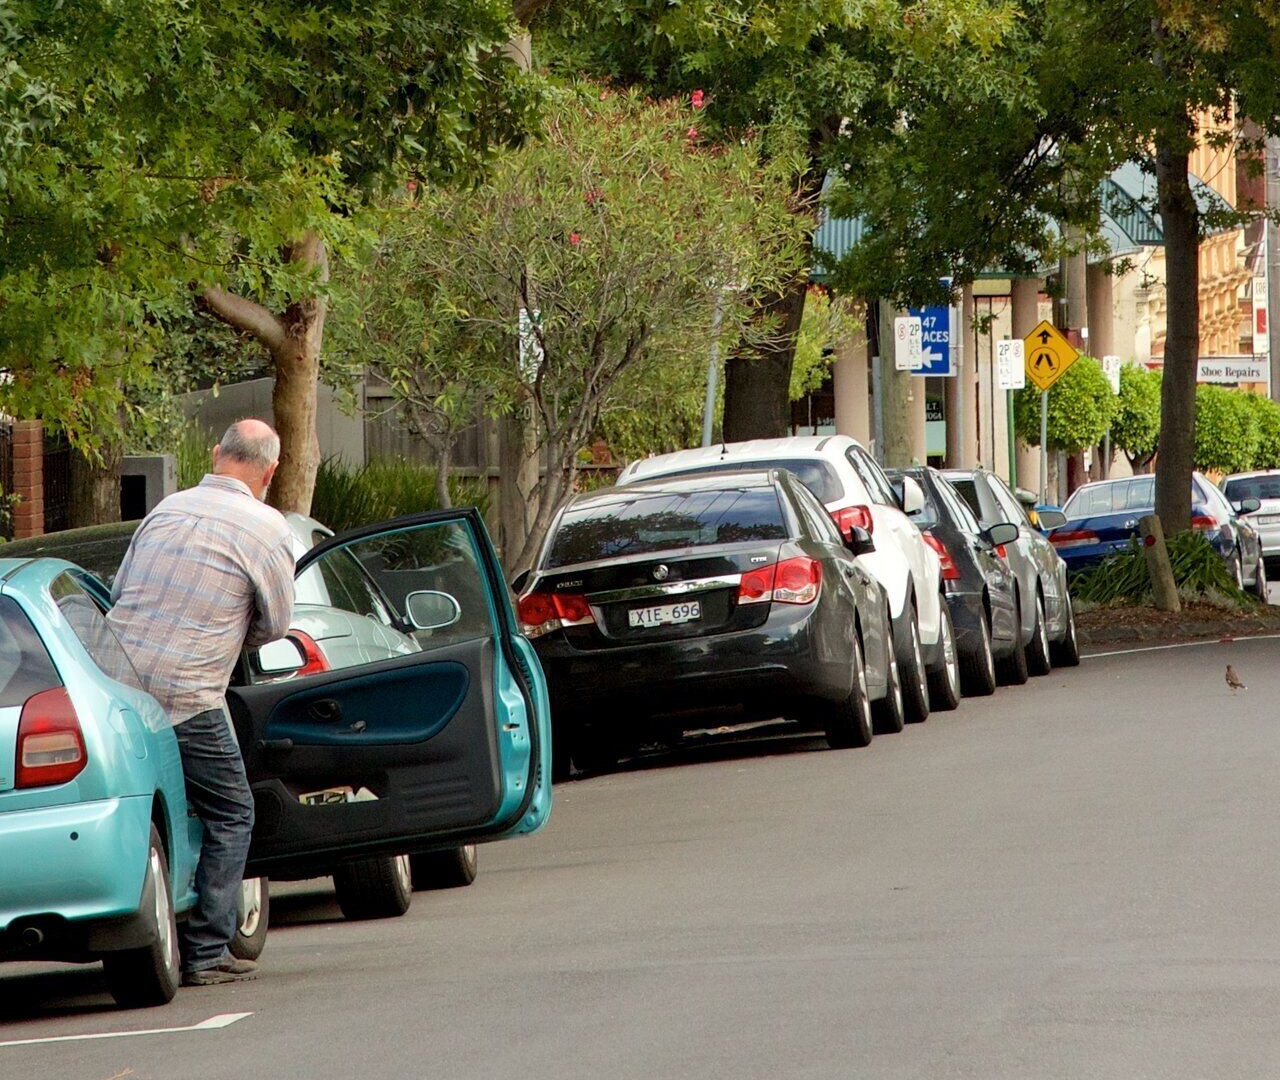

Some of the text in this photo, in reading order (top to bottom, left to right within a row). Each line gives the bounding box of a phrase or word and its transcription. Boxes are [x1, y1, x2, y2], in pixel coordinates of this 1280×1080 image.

[922, 316, 936, 328] 47
[909, 324, 920, 336] 2P
[921, 331, 949, 343] ACES
[1200, 366, 1261, 379] Shoe Repairs
[636, 603, 700, 623] XIE 696
